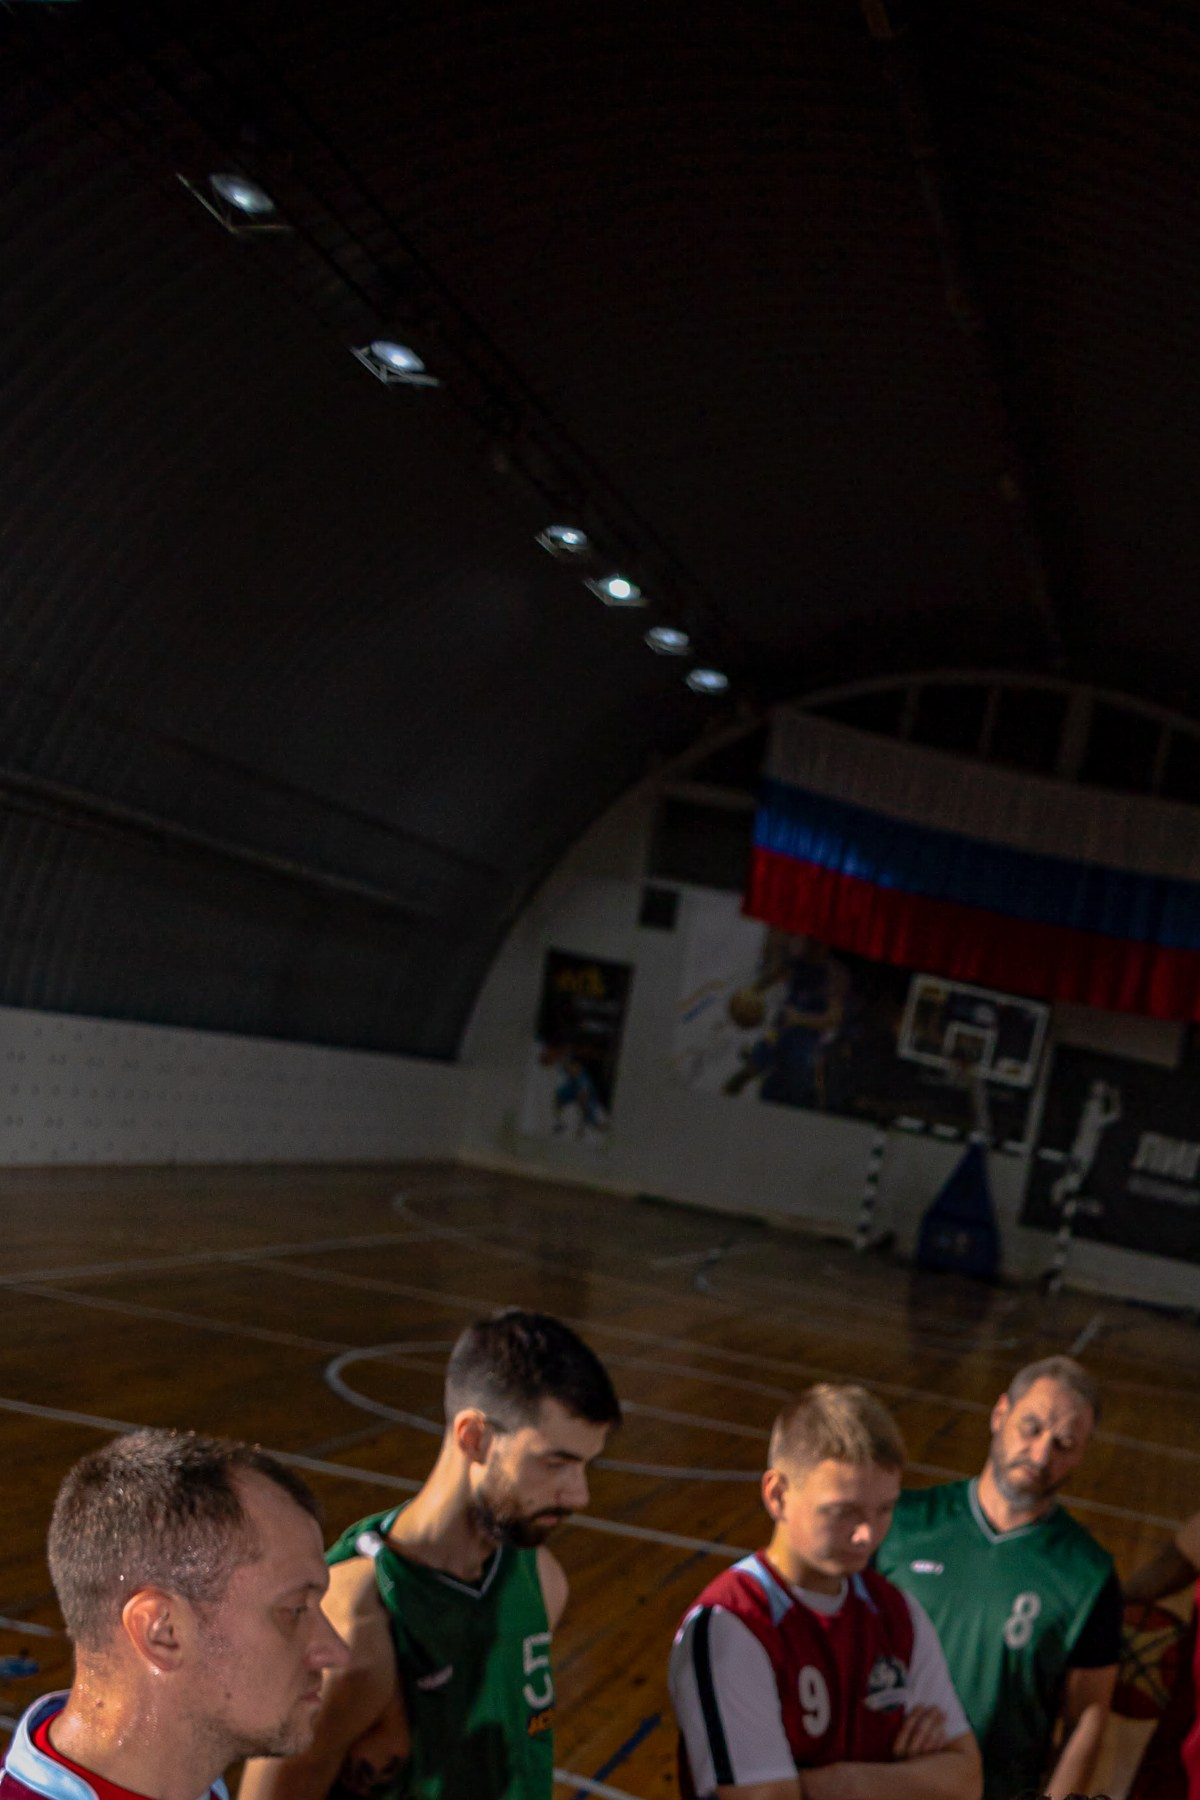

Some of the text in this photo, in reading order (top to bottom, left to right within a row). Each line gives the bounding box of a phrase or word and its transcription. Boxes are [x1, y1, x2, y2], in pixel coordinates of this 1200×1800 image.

[1004, 1591, 1042, 1649] 8
[522, 1631, 554, 1711] 5
[798, 1665, 832, 1739] 9
